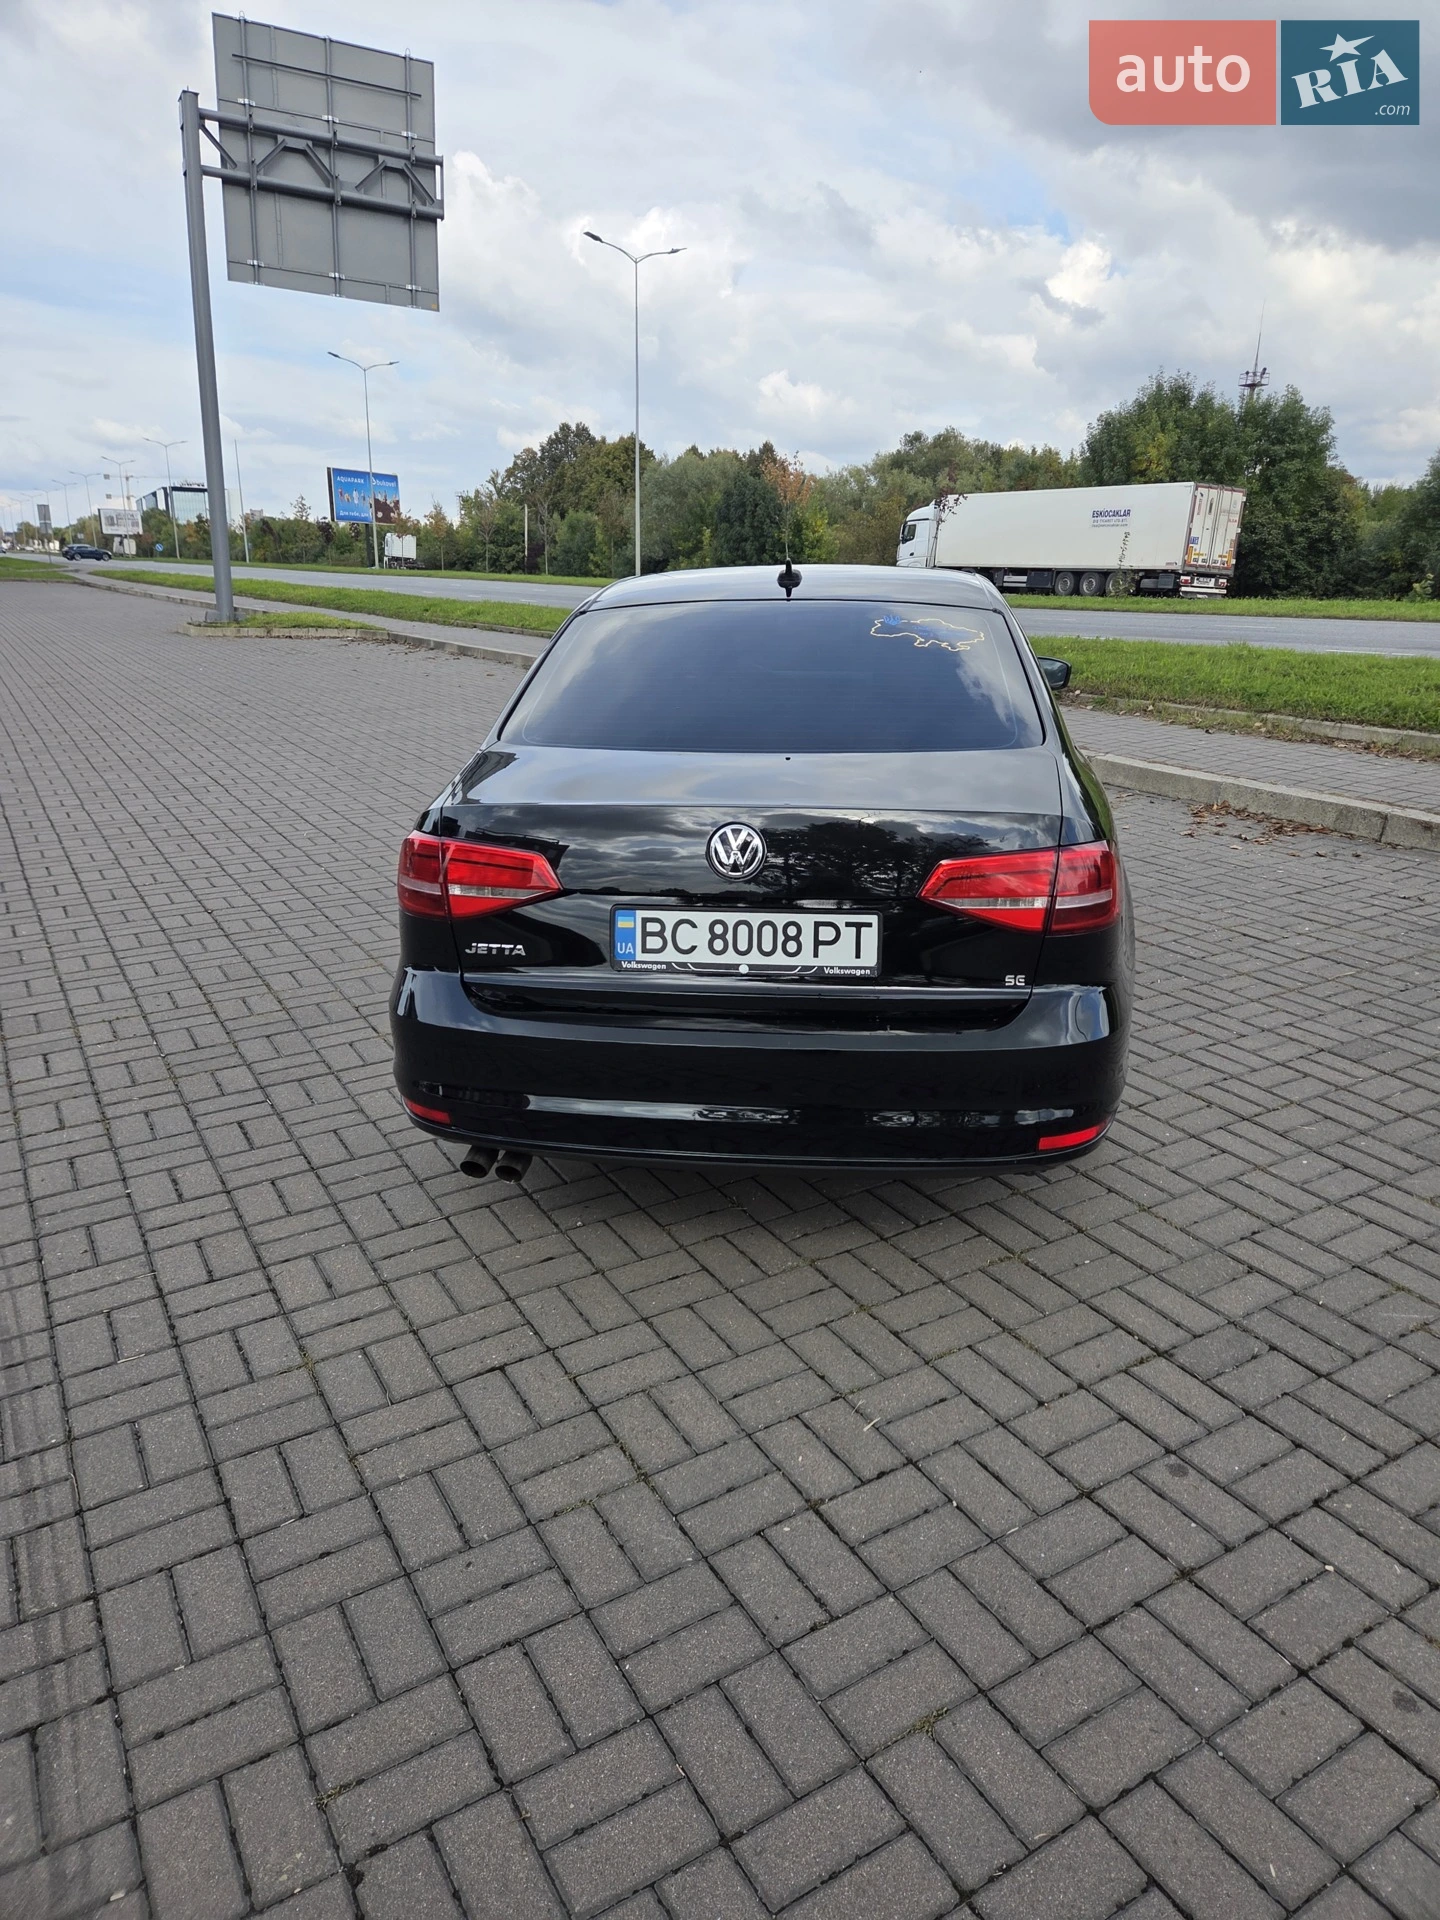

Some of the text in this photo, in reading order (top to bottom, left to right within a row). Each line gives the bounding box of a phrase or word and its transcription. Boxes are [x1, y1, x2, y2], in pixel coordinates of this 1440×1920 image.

[336, 476, 365, 484] AQUAPARK
[708, 919, 803, 958] 8008
[465, 943, 526, 956] JETTA
[617, 943, 635, 954] UA
[621, 961, 667, 971] Volkswagen
[824, 967, 871, 976] Volkswagen
[1005, 974, 1026, 986] SE
